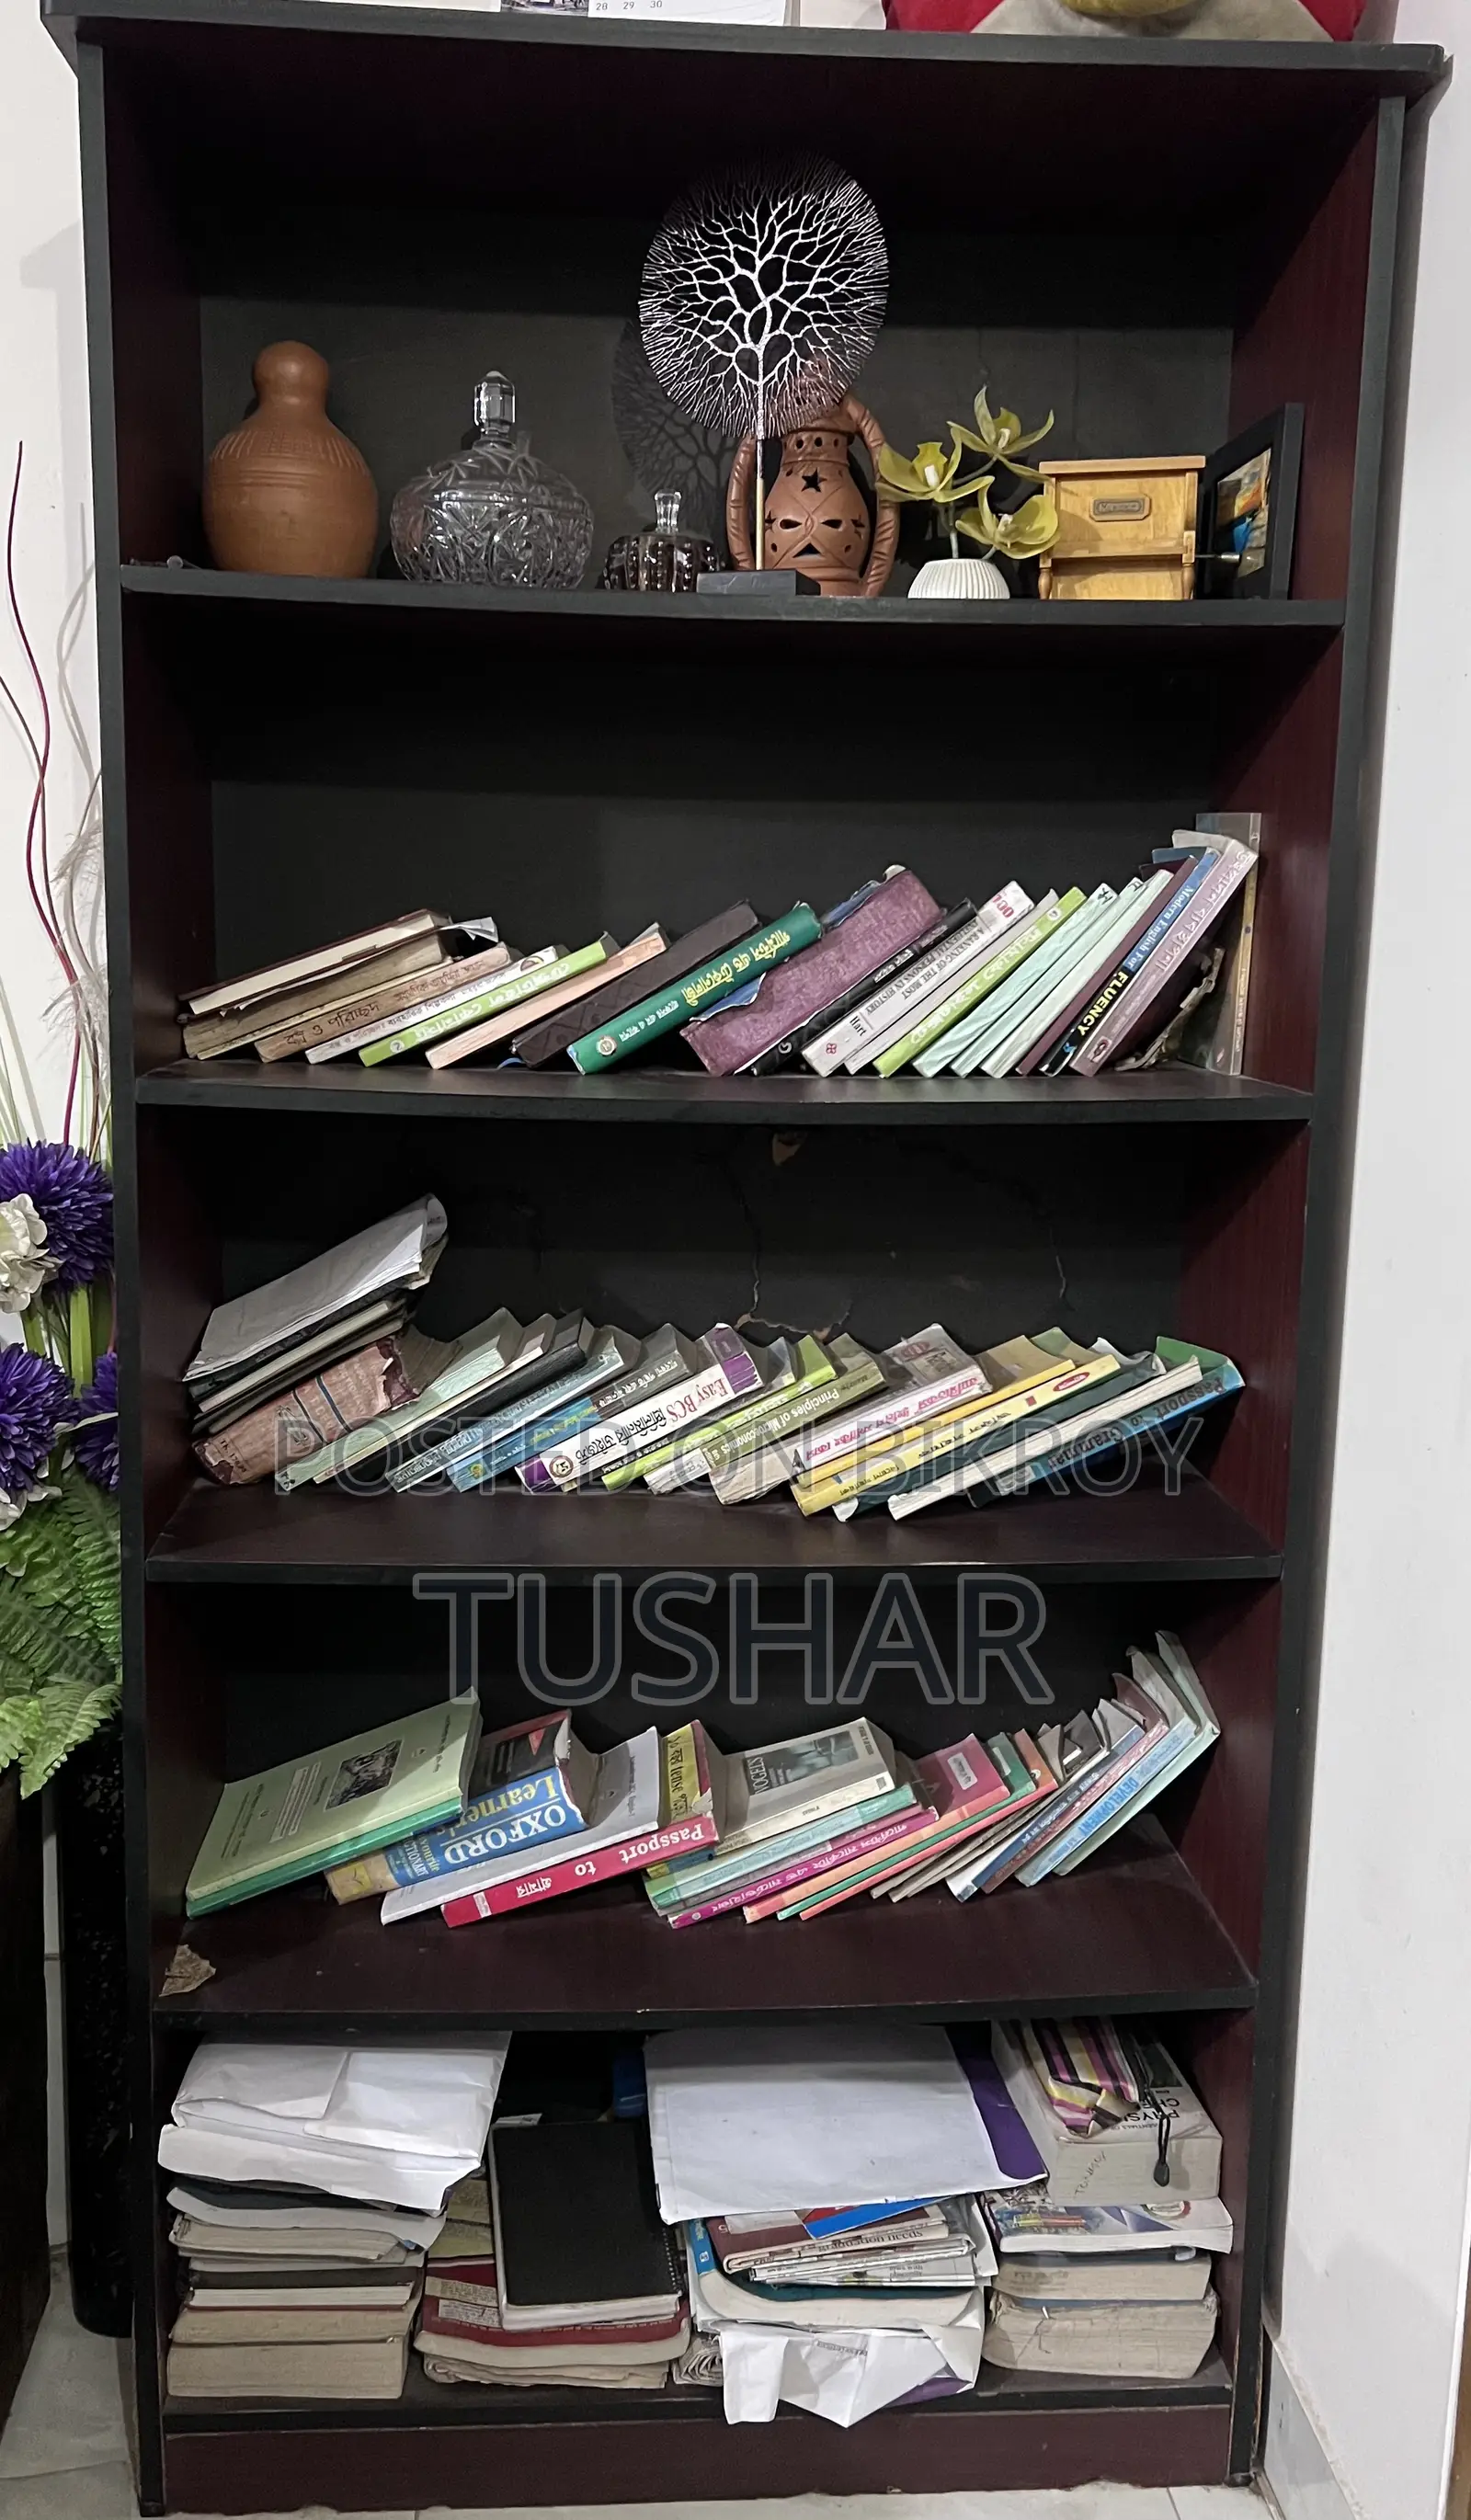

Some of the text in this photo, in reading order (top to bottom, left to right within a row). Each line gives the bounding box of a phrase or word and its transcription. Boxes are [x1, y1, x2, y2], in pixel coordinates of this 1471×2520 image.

[595, 0, 663, 11] 28 29 30
[992, 893, 1015, 919] 100
[1162, 883, 1194, 922] Modern
[944, 930, 980, 962] RANKING
[1138, 917, 1169, 954] English
[902, 952, 937, 982] PERSONS
[919, 967, 936, 983] THE
[1125, 950, 1145, 970] For
[899, 978, 922, 999] MOST
[1074, 967, 1129, 1038] FLUENCY
[848, 1015, 868, 1037] Hart
[691, 1372, 729, 1407] Easy
[788, 1385, 841, 1420] Principles
[664, 1393, 698, 1423] BCS
[778, 1410, 793, 1427] of
[719, 1417, 781, 1456] Microeconomics
[1044, 1375, 1226, 1473] Passport to Grammar
[668, 1766, 685, 1793] tense
[1075, 1776, 1142, 1839] DEVELOPMENT
[444, 1804, 567, 1864] OXFORD
[616, 1819, 706, 1865] Passport
[572, 1858, 599, 1880] to
[513, 1873, 554, 1899] গ্রামার
[886, 2226, 923, 2242] needs
